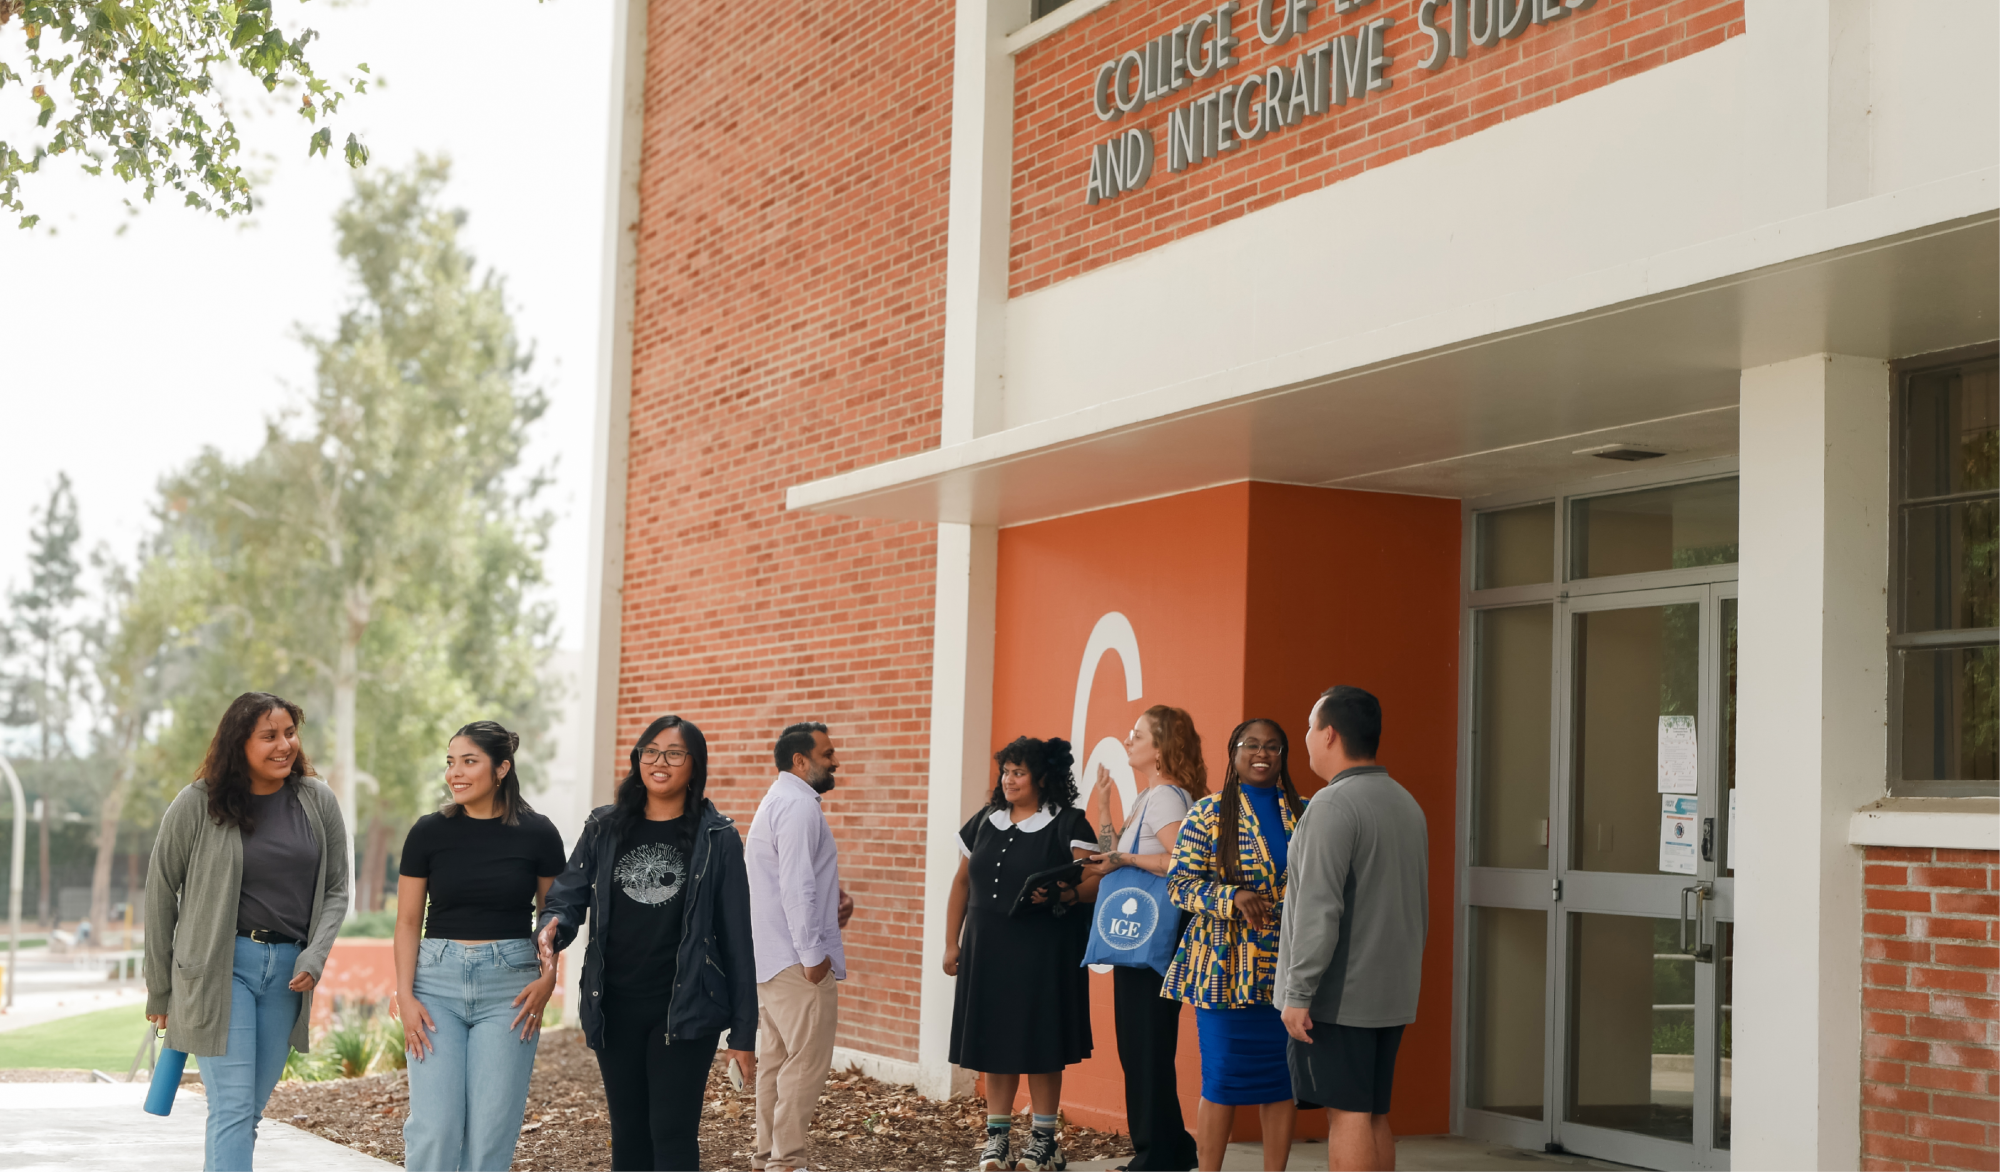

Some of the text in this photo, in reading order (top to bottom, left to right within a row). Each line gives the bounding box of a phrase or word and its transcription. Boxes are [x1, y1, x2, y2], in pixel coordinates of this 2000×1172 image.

[1086, 128, 1154, 205] AND
[1167, 17, 1394, 174] INTEGRATIVE
[1094, 0, 1317, 122] COLLEGE OF
[1108, 918, 1141, 938] IGE
